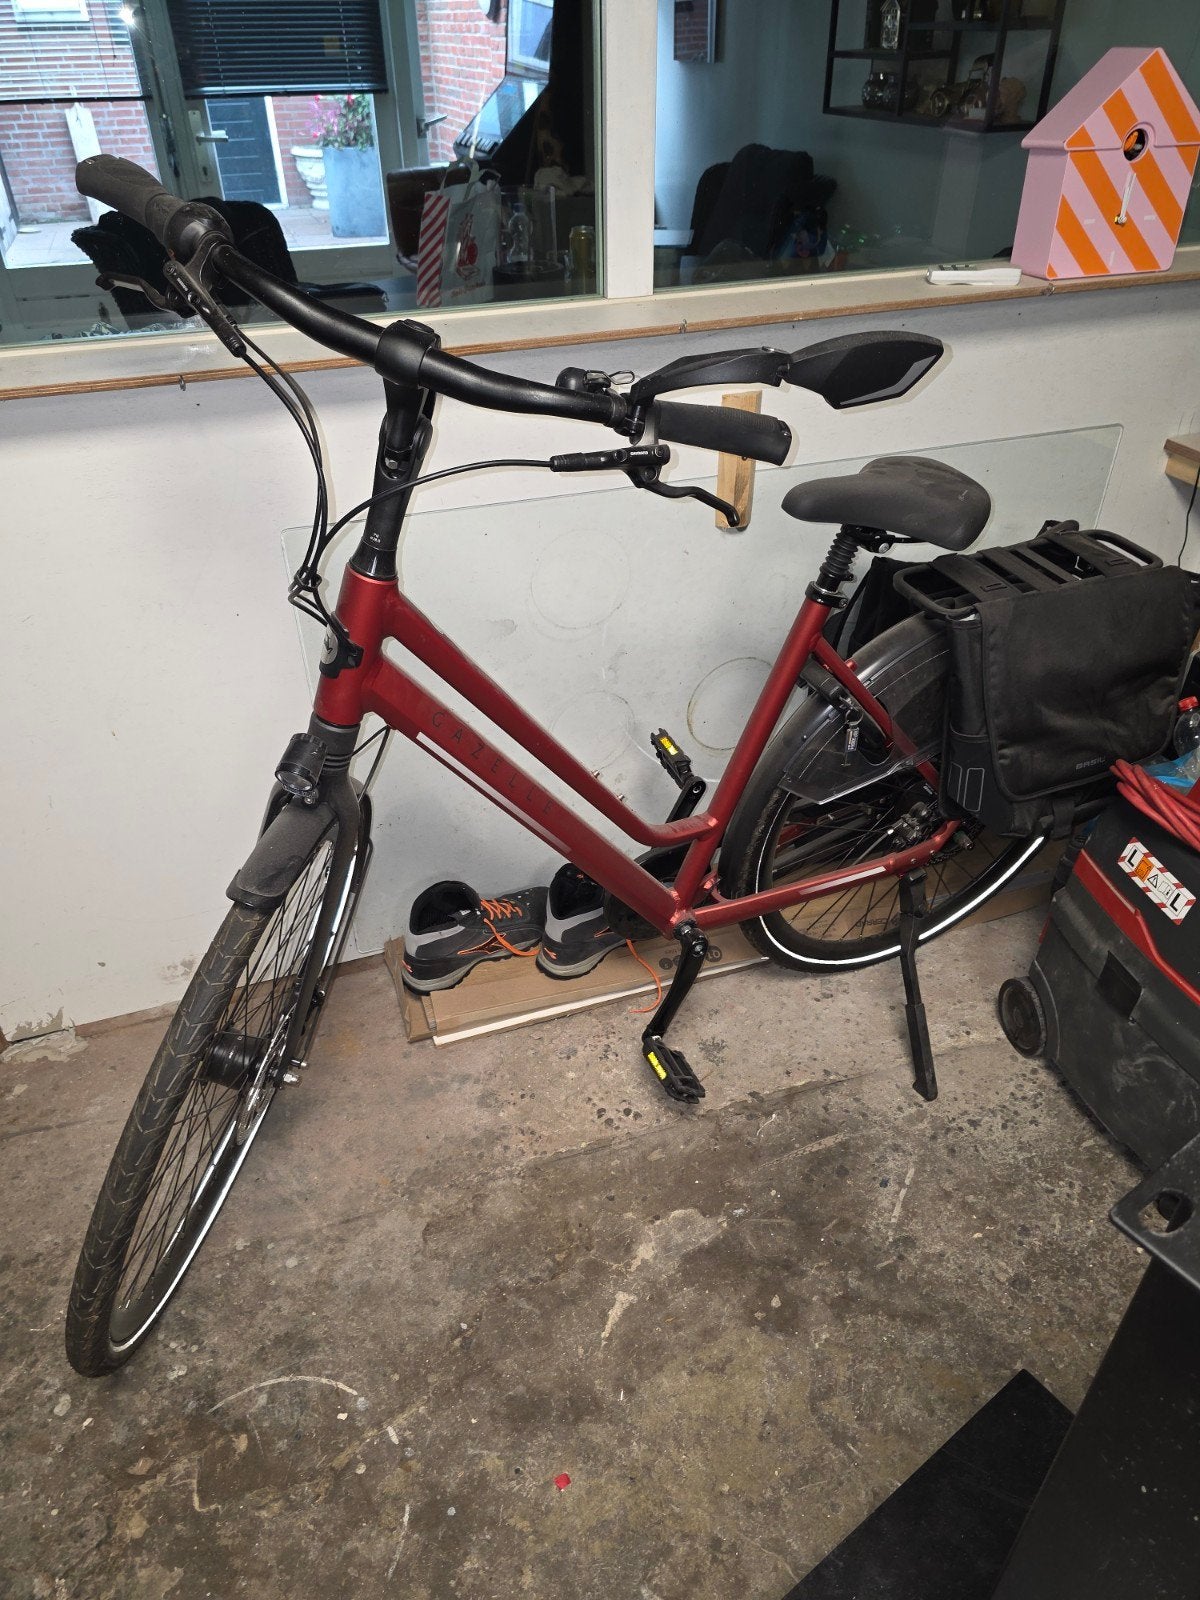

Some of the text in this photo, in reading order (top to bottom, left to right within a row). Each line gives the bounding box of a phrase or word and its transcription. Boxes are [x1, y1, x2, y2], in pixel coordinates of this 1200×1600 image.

[432, 711, 553, 813] GAZELLE
[1127, 849, 1138, 867] L
[1169, 892, 1181, 912] L
